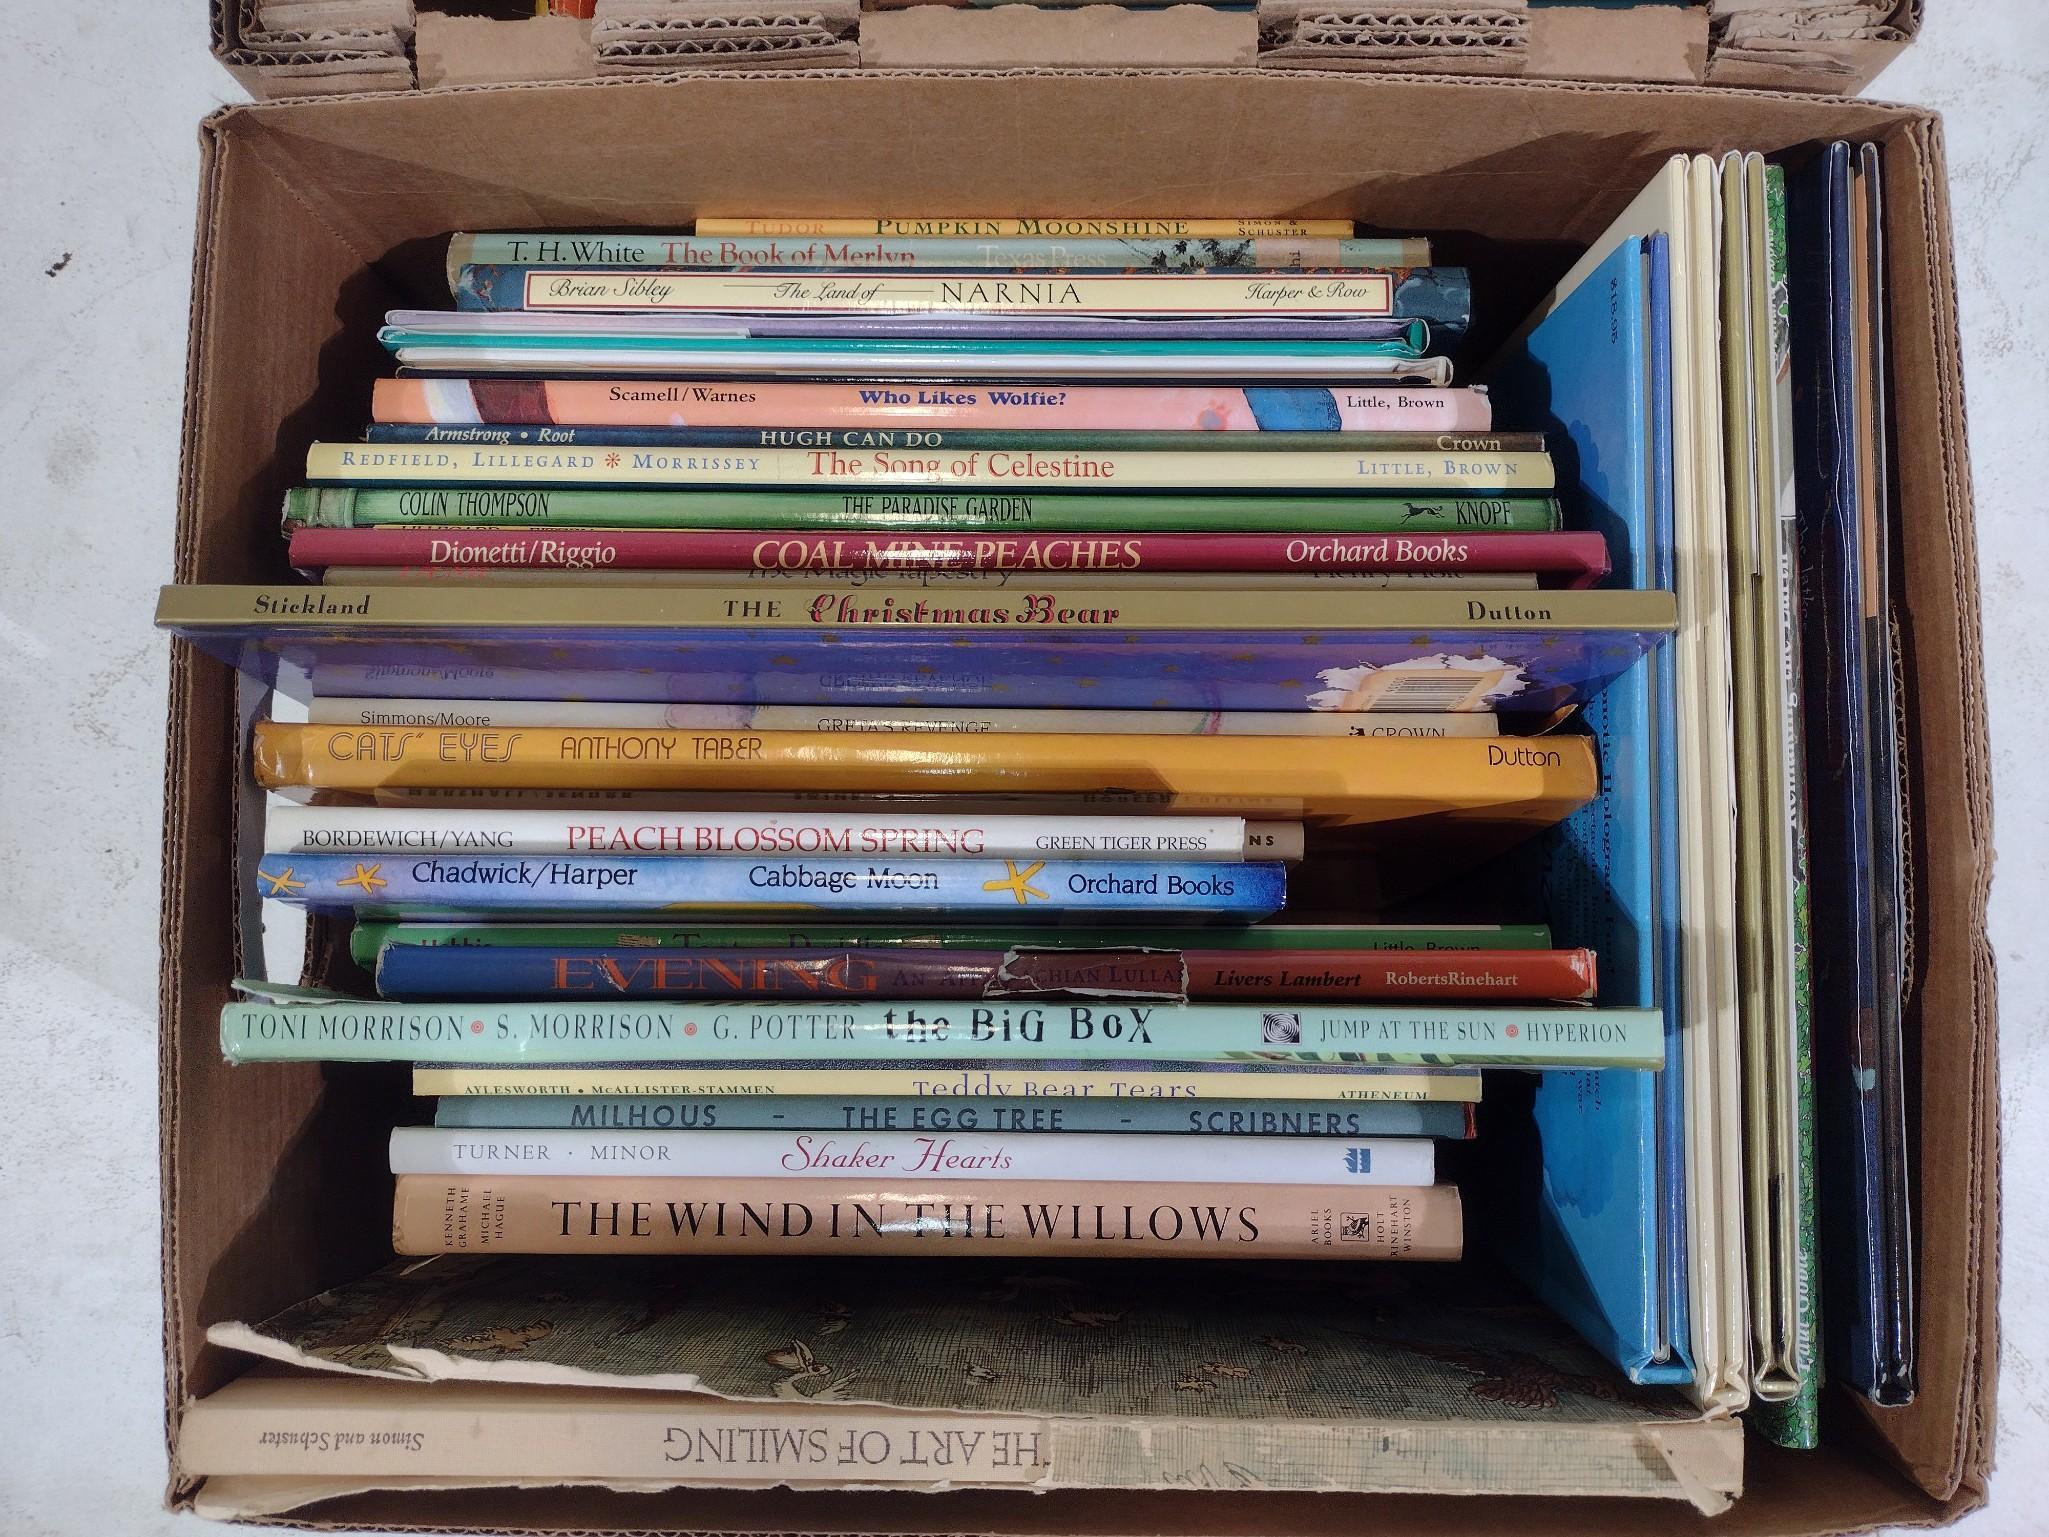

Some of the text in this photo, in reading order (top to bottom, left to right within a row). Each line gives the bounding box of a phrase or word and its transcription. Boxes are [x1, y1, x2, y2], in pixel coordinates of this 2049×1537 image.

[745, 220, 825, 234] TUDOR
[875, 219, 1190, 236] PUMPKIN MOONSHINE
[1238, 228, 1309, 237] SCHUSTER
[508, 241, 645, 264] T. H. White
[661, 242, 915, 266] The Book of Merlyn
[976, 244, 1107, 267] Texas Press
[549, 277, 675, 302] Brian Sibley
[773, 280, 881, 302] The Land of
[940, 281, 1083, 305] NARNIA
[1245, 281, 1370, 301] Harper & Row
[609, 386, 757, 403] Scamell/Warnes
[859, 390, 1067, 407] Who Likes Wolfie?
[1346, 394, 1446, 411] Little, Brown
[424, 426, 576, 445] Armstrong Root
[759, 430, 943, 449] HUGH CAN DO
[1436, 435, 1502, 451] Crown
[342, 451, 761, 471] REDFIELD, LILLEGARD MORRISSEY
[807, 451, 1115, 484] The Song of Celestine
[1357, 459, 1519, 478] LITTLE, BROWN
[399, 491, 550, 518] COLIN THOMPSON
[842, 496, 1033, 523] THE PARADISE GARDEN
[1455, 501, 1513, 525] KNOPF
[429, 540, 618, 569] Dionetti/Riggio
[752, 540, 1143, 570] COAL MINE PEACHES
[1285, 539, 1469, 563] Orchard Books
[253, 593, 371, 616] Stickland
[724, 593, 1121, 625] THE Christmas Bear
[1467, 600, 1553, 621] Dutton
[360, 710, 491, 727] Simmons/Moore
[439, 732, 523, 764] EYES
[560, 736, 764, 761] ANTHONY TABER
[1488, 744, 1562, 768] Dutton
[303, 829, 514, 849] BORDEWICH/YANG
[567, 826, 985, 854] PEACH BLOSSOM SPRING
[1036, 835, 1207, 852] GREEN TIGER PRESS
[412, 860, 639, 889] Chadwick/Harper
[748, 865, 940, 893] Cabbage Moon
[1068, 872, 1235, 897] Orchard Books
[551, 958, 878, 993] EVENING
[1214, 969, 1363, 988] Livers Lambert
[1385, 970, 1519, 987] RobertsRinehart
[242, 1012, 857, 1040] TONI MORRISON S. MORRISON G. POTTER
[883, 1007, 949, 1043] the
[971, 1007, 1045, 1043] BiG
[1320, 1018, 1628, 1043] JUMP AT THE SUN HYPERION
[464, 1085, 571, 1095] AYLESWORTH
[911, 1073, 1198, 1098] Teddy Bear Tears
[1337, 1089, 1429, 1100] ATHENEUM
[570, 1104, 1361, 1136] MILHOUS THE EGG TREE SCRIBNERS
[453, 1144, 673, 1161] TURNER MINOR
[781, 1136, 1014, 1173] Shaker Hearts
[445, 1187, 456, 1247] KENNETH
[458, 1186, 470, 1249] GRAHAME
[481, 1187, 492, 1245] MICHAEL
[495, 1196, 505, 1239] HAGUE
[551, 1200, 1261, 1242] THE WIND IN THE WILLOWS
[1310, 1208, 1319, 1245] ARIEL
[1323, 1207, 1333, 1246] BOOKS
[1376, 1210, 1386, 1244] HOLT
[1402, 1198, 1411, 1254] WINSTON
[258, 1430, 425, 1452] Simon and Schuster
[662, 1427, 829, 1464] SMILING
[838, 1429, 891, 1465] OF
[901, 1430, 980, 1466] ART
